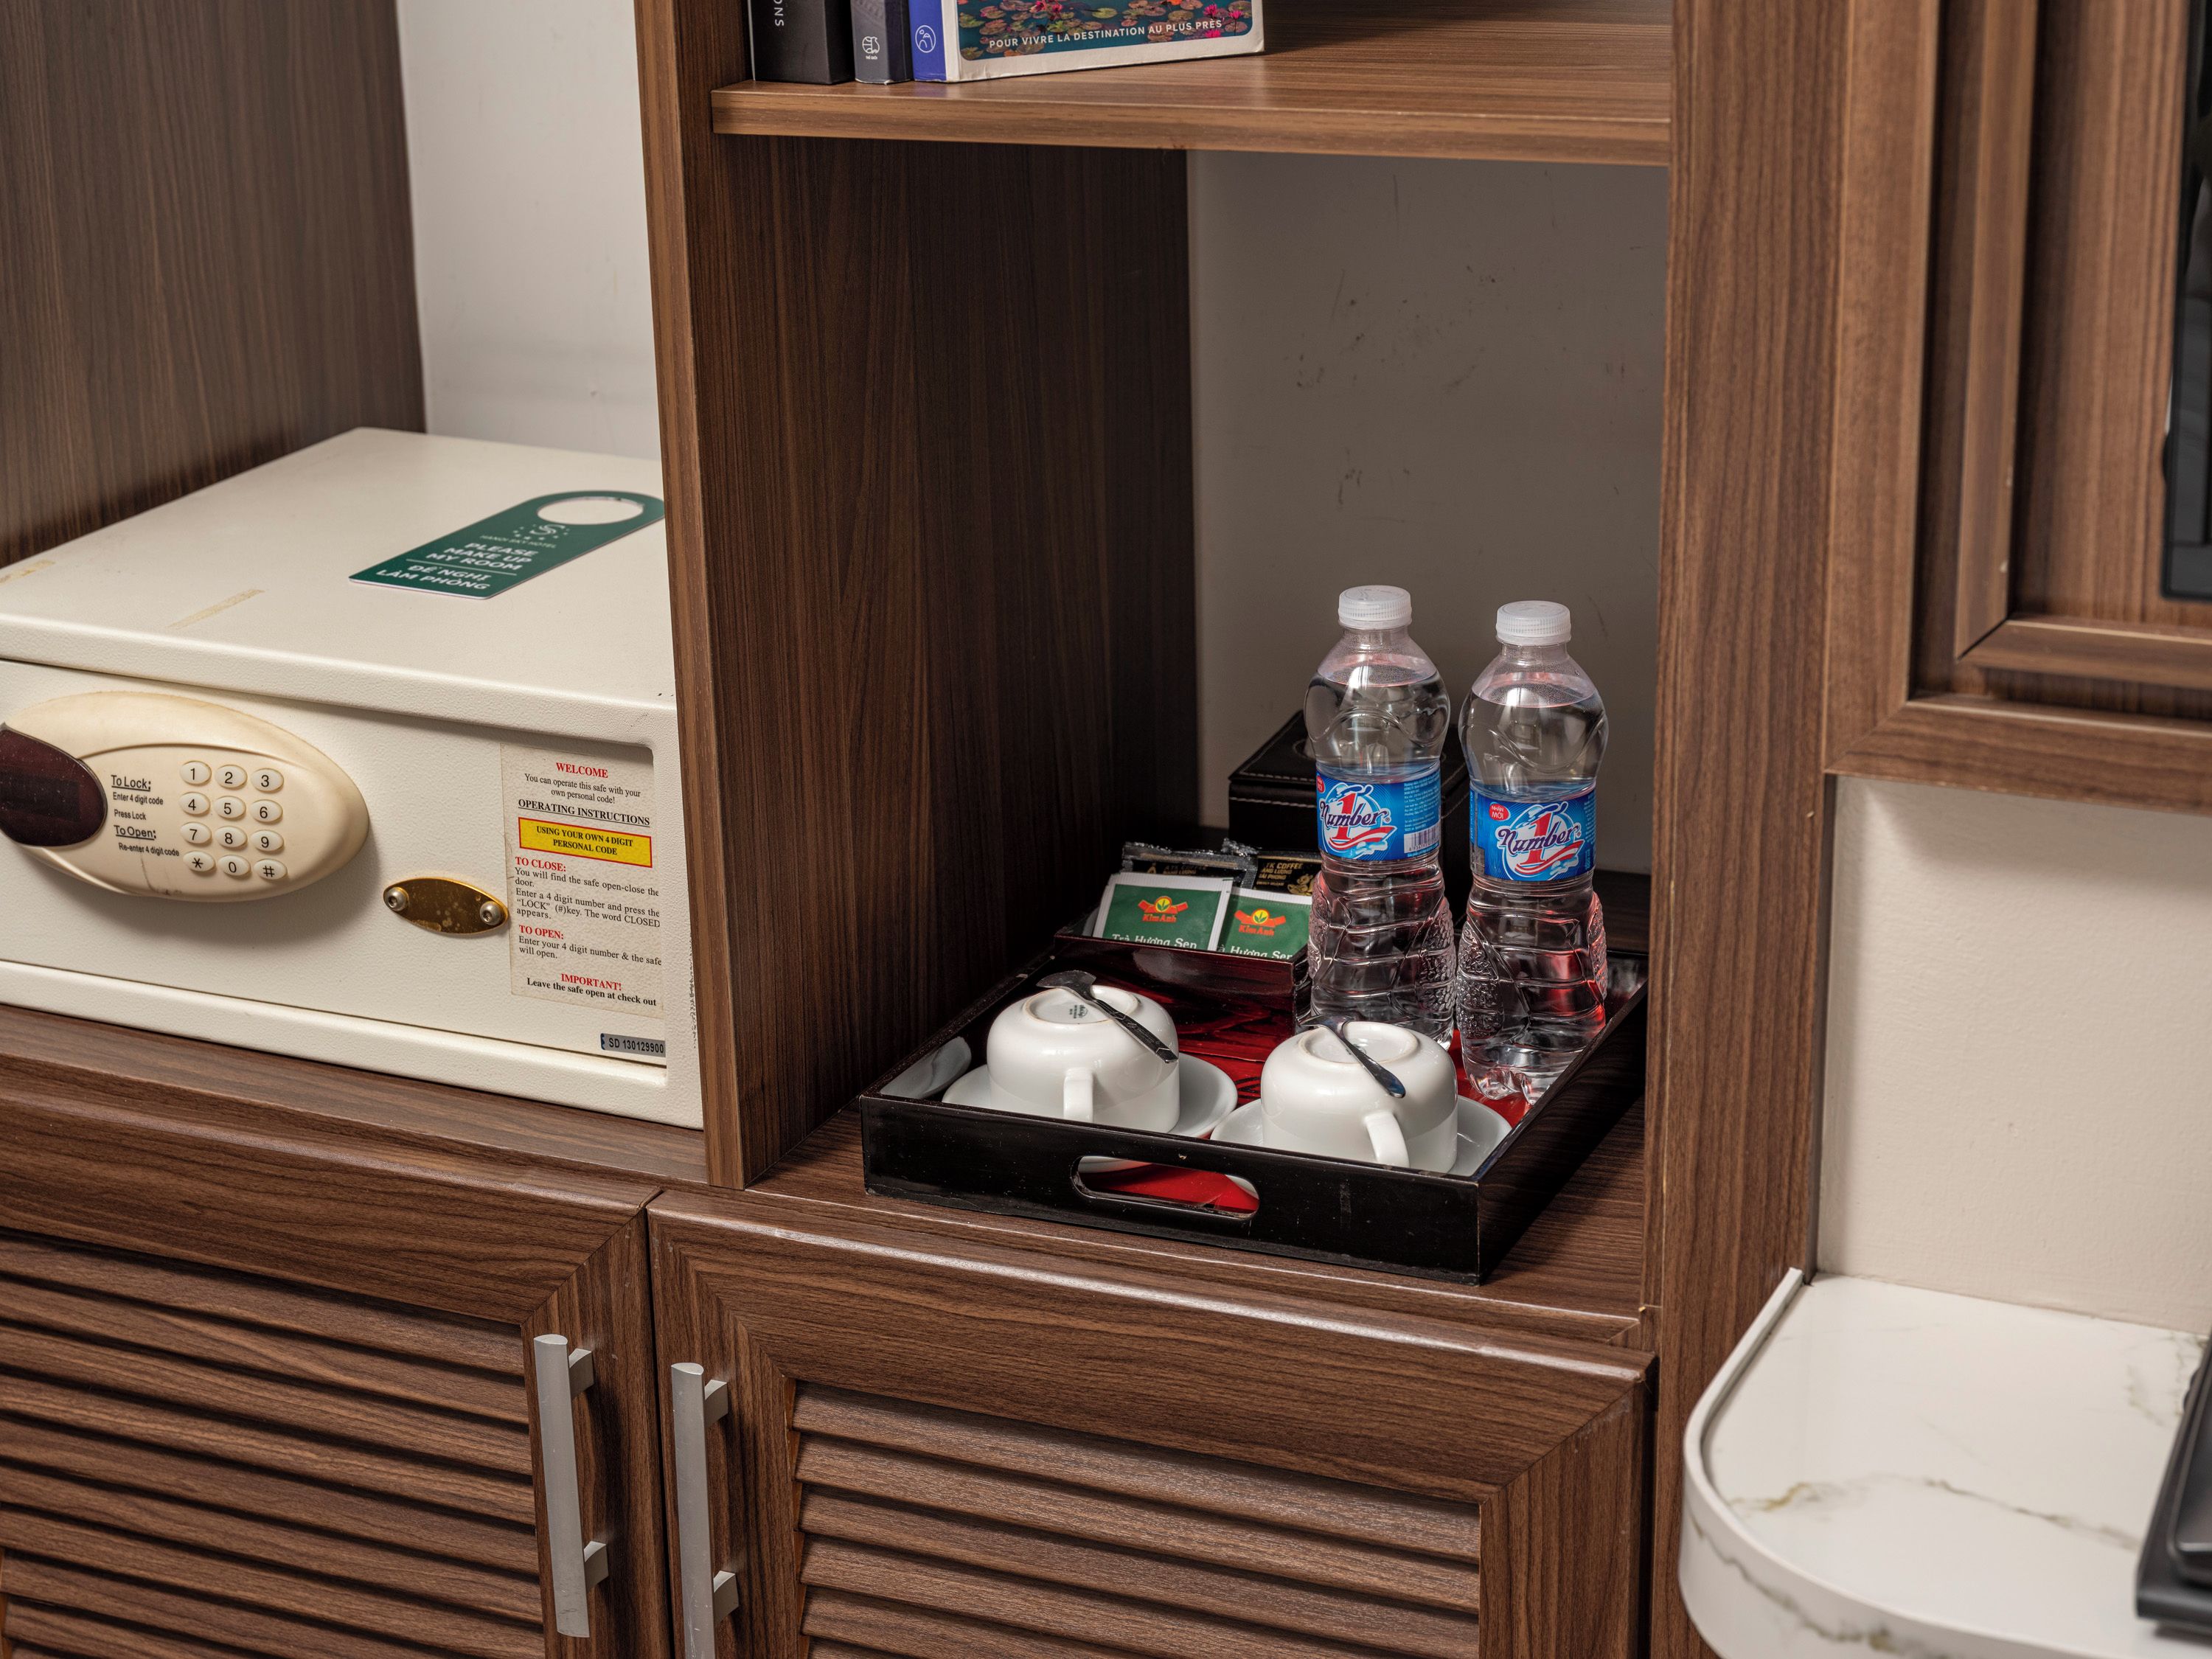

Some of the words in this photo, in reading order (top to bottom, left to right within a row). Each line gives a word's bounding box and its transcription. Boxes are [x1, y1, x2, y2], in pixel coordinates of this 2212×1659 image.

[989, 38, 1018, 48] POUR
[1021, 35, 1054, 45] VIVRE
[1057, 33, 1071, 43] LA
[1074, 27, 1145, 41] DESTINATION
[1148, 24, 1163, 34] AU
[1166, 22, 1192, 32] PLUS
[1196, 18, 1222, 29] PRÈS
[443, 547, 501, 560] MAKE
[502, 555, 532, 563] UP
[465, 542, 539, 557] PLEASE
[425, 553, 460, 561] MY
[460, 557, 523, 570] ROOM
[375, 569, 420, 580] LÀM
[420, 576, 490, 589] PHÒNG
[437, 568, 492, 581] NGHỊ
[190, 768, 195, 780] 1
[224, 771, 233, 784] 2
[261, 774, 270, 787] 3
[556, 762, 608, 778] WELCOME
[111, 774, 122, 787] To
[124, 776, 151, 790] Lock:
[524, 773, 538, 783] You
[540, 777, 552, 785] can
[553, 779, 577, 789] operate
[579, 782, 591, 790] this
[593, 785, 607, 793] safe
[608, 786, 624, 795] with
[625, 789, 641, 798] your
[113, 791, 129, 801] Enter
[130, 793, 134, 801] 4
[134, 794, 147, 805] digit
[148, 796, 164, 805] code
[567, 791, 595, 801] personal
[597, 795, 615, 804] code!
[114, 809, 131, 819] Press
[132, 811, 146, 821] Lock
[188, 799, 196, 810] 4
[223, 802, 232, 815] 5
[260, 806, 268, 818] 6
[518, 799, 575, 815] OPERATING
[577, 806, 650, 826] INSTRUCTIONS
[114, 824, 126, 835] To
[127, 826, 157, 839] Open:
[189, 829, 198, 841] 7
[224, 832, 233, 844] 8
[260, 835, 269, 848] 9
[536, 826, 560, 836] USING
[561, 830, 583, 840] YOUR
[585, 832, 604, 843] OWN
[605, 835, 610, 844] 4
[611, 837, 633, 847] DIGIT
[119, 842, 144, 853] Re-enter
[145, 845, 150, 853] 4
[150, 845, 164, 856] digit
[164, 847, 179, 856] code
[553, 839, 594, 852] PERSONAL
[595, 845, 618, 855] CODE
[228, 861, 237, 873] 0
[262, 865, 275, 877] #
[515, 856, 529, 866] TO
[531, 859, 566, 872] CLOSE:
[515, 867, 530, 877] You
[532, 869, 548, 879] will
[551, 872, 566, 882] find
[568, 875, 581, 884] the
[583, 878, 599, 887] safe
[602, 882, 645, 894] open-close
[647, 887, 659, 897] the
[515, 877, 535, 887] door.
[515, 888, 538, 898] Enter
[546, 891, 552, 900] 4
[554, 894, 573, 905] digit
[575, 898, 605, 909] number
[607, 902, 622, 912] and
[625, 906, 645, 916] press
[647, 908, 660, 917] the
[516, 908, 552, 919] appears.
[585, 908, 599, 919] The
[602, 912, 622, 922] word
[624, 915, 661, 928] CLOSED
[518, 925, 533, 934] TO
[535, 928, 564, 939] OPEN:
[518, 936, 540, 946] Enter
[541, 941, 560, 950] your
[561, 942, 567, 950] 4
[569, 943, 588, 954] digit
[590, 947, 619, 959] number
[622, 952, 629, 960] &
[631, 953, 644, 963] the
[646, 956, 662, 966] safe
[1174, 937, 1197, 949] Sen
[519, 946, 534, 955] will
[536, 950, 557, 959] open.
[561, 973, 622, 991] IMPORTANT!
[526, 978, 551, 989] Leave
[553, 981, 566, 991] the
[567, 984, 584, 994] safe
[585, 988, 605, 998] open
[607, 992, 615, 1000] at
[617, 993, 641, 1004] check
[643, 998, 657, 1006] out
[608, 1037, 620, 1048] SD
[622, 1040, 664, 1054] 130129900
